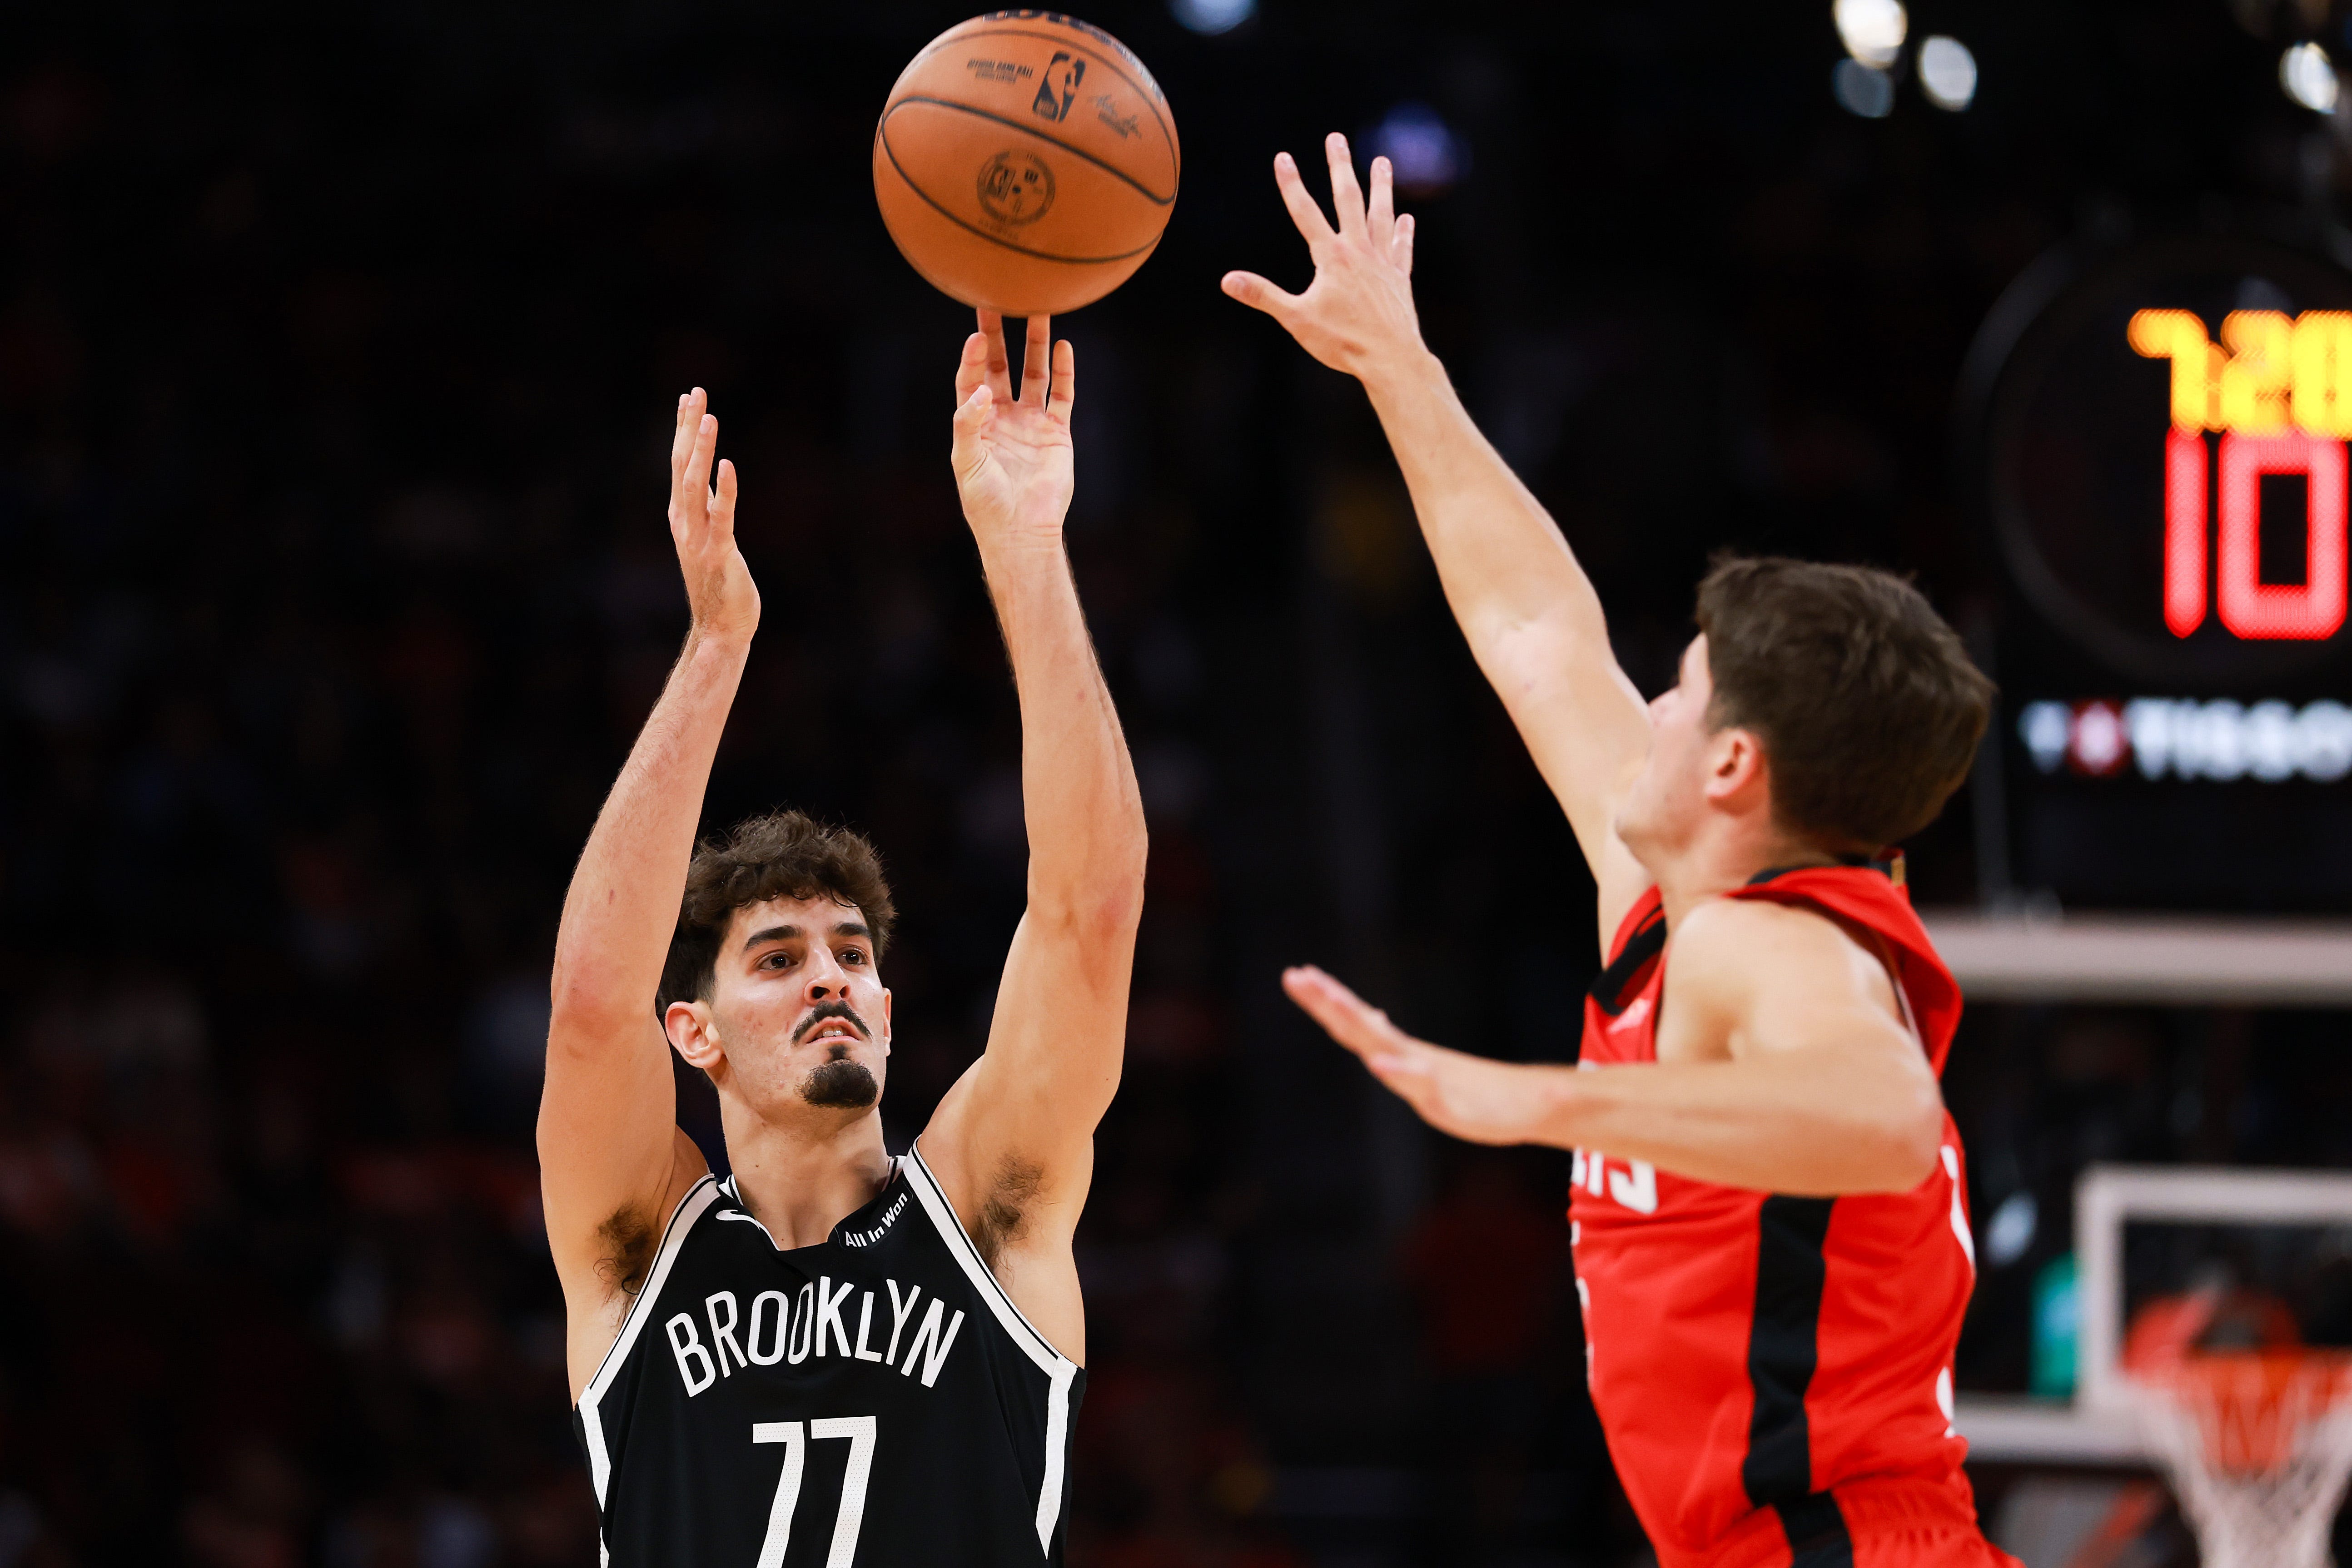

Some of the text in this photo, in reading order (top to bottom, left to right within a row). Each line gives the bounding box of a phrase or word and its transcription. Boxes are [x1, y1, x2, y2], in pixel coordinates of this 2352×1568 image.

[2163, 425, 2348, 639] 10
[845, 1192, 908, 1247] All In Won
[665, 1275, 965, 1397] BROOKLYN
[752, 1415, 876, 1568] 77
